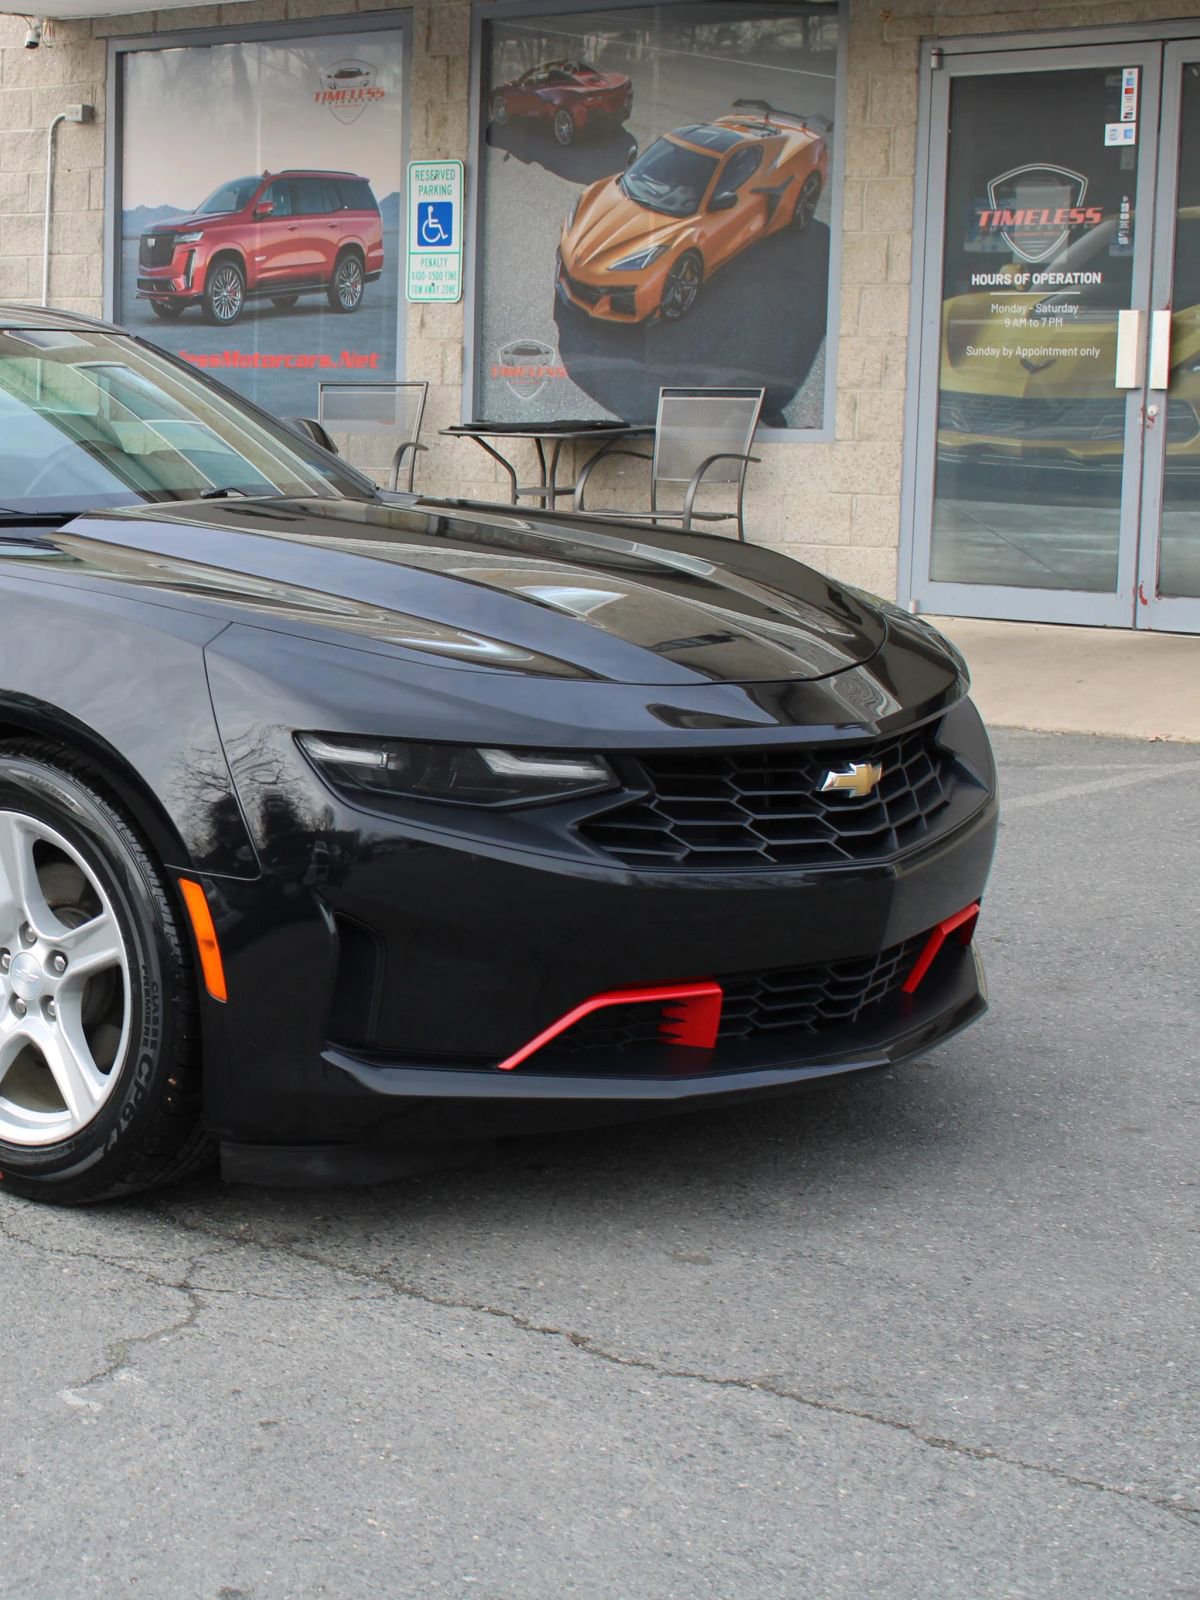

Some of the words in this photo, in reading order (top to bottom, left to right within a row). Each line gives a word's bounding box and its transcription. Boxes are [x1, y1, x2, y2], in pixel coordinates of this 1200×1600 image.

[314, 87, 385, 102] TIMELESS
[415, 168, 456, 181] RESERVED
[418, 184, 452, 196] PARKING
[977, 206, 1103, 227] TIMELESS
[420, 256, 448, 268] PENALTY
[445, 270, 457, 281] FINE
[971, 273, 1012, 286] HOURS
[1014, 272, 1030, 285] OF
[1032, 272, 1102, 285] OPERATION
[410, 284, 423, 294] TOW
[424, 284, 440, 294] AWAY
[441, 284, 456, 294] ZONE
[991, 303, 1028, 316] Monday
[1035, 303, 1079, 315] Saturday
[1004, 318, 1011, 328] 9
[1012, 318, 1027, 328] AM
[1029, 318, 1039, 328] to
[1041, 318, 1047, 327] 7
[1049, 318, 1063, 327] PM
[966, 345, 1001, 358] Sunday
[1002, 346, 1013, 357] by
[1015, 346, 1079, 358] Appointment
[1080, 346, 1100, 359] only
[149, 981, 161, 1051] CLASSE
